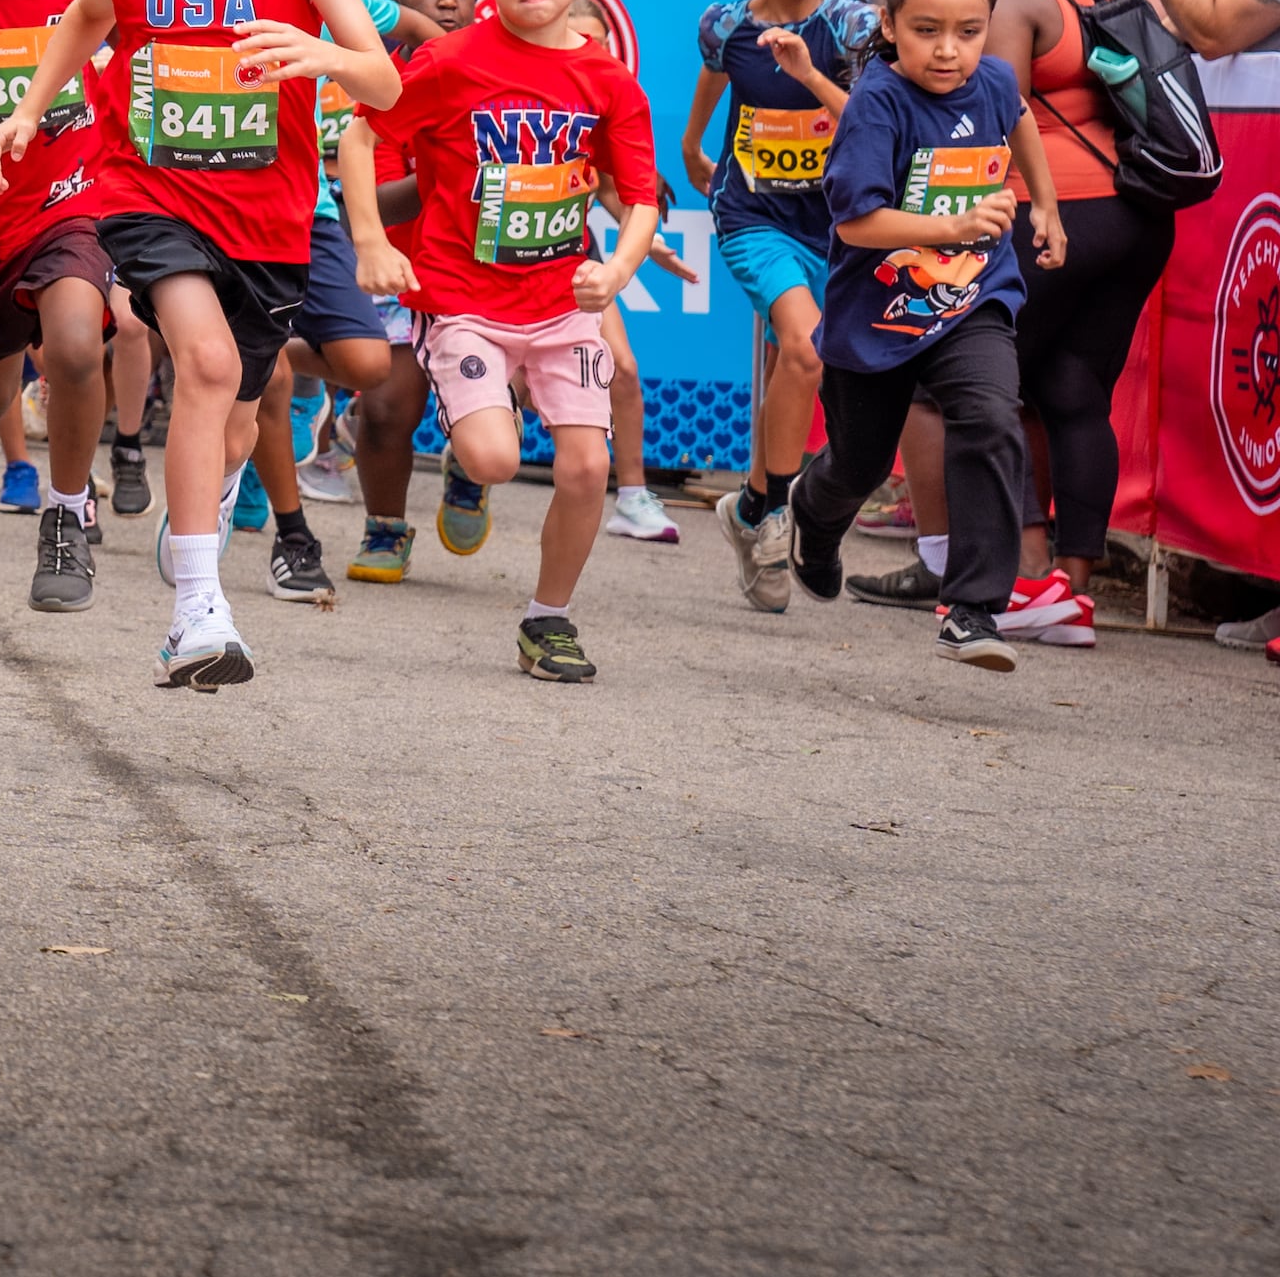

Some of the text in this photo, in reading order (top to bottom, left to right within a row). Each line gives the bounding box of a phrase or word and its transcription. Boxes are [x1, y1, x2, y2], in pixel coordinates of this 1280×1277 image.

[132, 45, 153, 113] MILE
[171, 67, 211, 79] Microsoft
[161, 101, 269, 140] 8414
[471, 109, 600, 166] NYC
[757, 146, 831, 172] 908
[905, 151, 933, 207] MILE
[481, 167, 506, 222] MILE
[522, 182, 555, 192] Microsoft
[506, 202, 581, 240] 8166
[573, 346, 616, 390] 10
